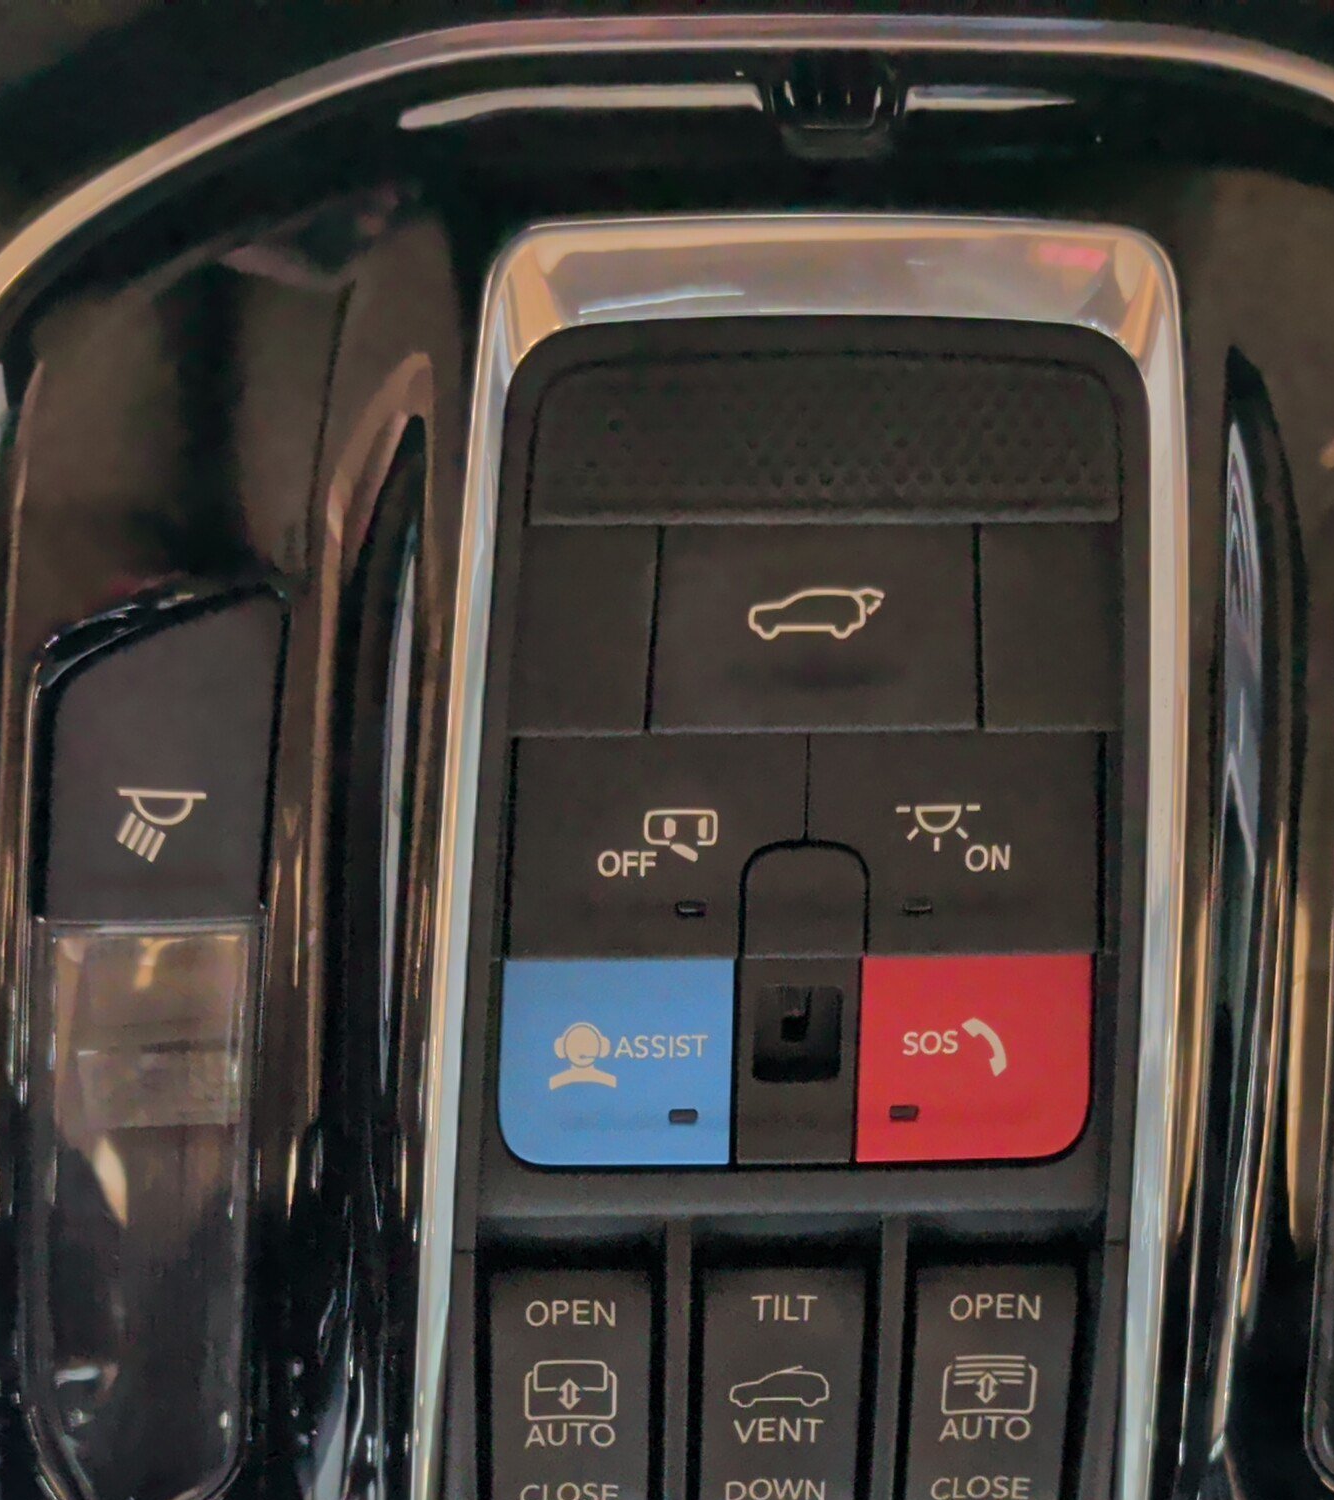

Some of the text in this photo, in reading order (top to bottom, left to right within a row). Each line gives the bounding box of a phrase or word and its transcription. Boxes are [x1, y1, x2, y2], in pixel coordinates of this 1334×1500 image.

[597, 850, 658, 878] OFF
[965, 845, 1011, 872] ON
[614, 1034, 709, 1059] ASSIST
[902, 1030, 959, 1056] SOS
[525, 1299, 616, 1327] OPEN
[751, 1294, 818, 1322] TILT
[949, 1293, 1041, 1321] OPEN
[525, 1422, 616, 1448] AUTO
[733, 1417, 824, 1444] VENT
[938, 1415, 1031, 1442] AUTO
[930, 1475, 1031, 1500] CLOSE
